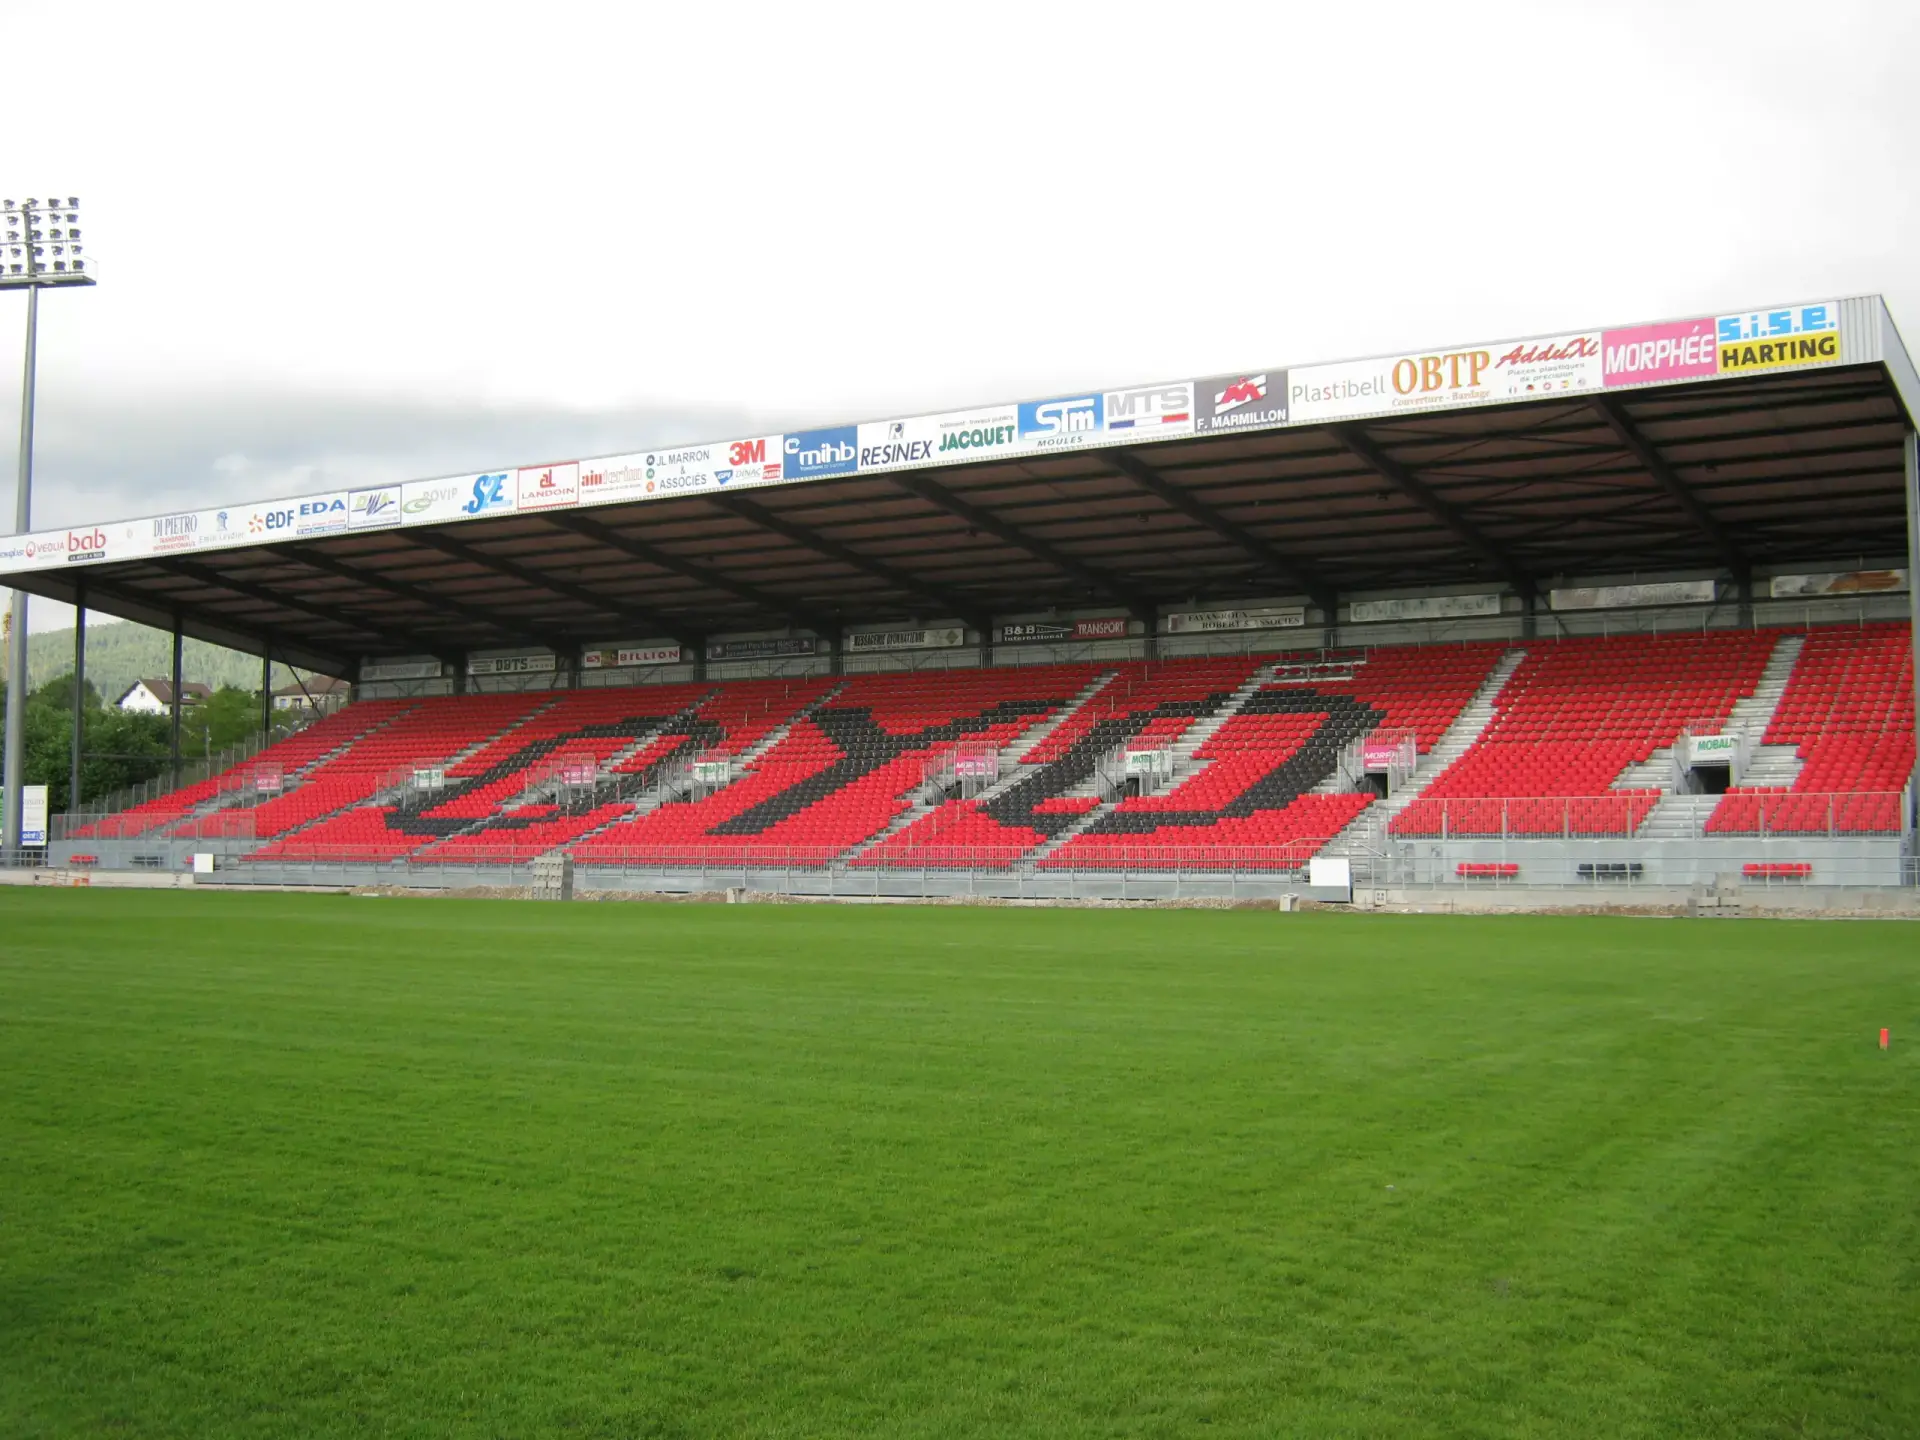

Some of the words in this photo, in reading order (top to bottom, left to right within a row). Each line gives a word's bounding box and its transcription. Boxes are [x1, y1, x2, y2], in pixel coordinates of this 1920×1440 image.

[1605, 325, 1715, 375] MORPHÉE
[1721, 336, 1836, 368] HARTING
[1391, 350, 1490, 395] OBTP
[1291, 375, 1386, 404] Plastibell
[1107, 386, 1190, 417] MTS
[1197, 418, 1207, 430] F.
[1211, 408, 1286, 429] MARMILLON
[938, 425, 1016, 452] JACQUET
[1037, 435, 1083, 447] MOULES
[656, 455, 667, 467] JL
[668, 449, 711, 465] MARRON
[728, 439, 766, 466] 3M
[860, 440, 933, 466] RESINEX
[680, 466, 686, 475] &
[521, 486, 576, 500] LANDOIN
[299, 499, 346, 516] EDA
[153, 519, 163, 537] DI
[164, 514, 198, 536] PIETRO
[36, 541, 64, 553] VEOLIA
[67, 527, 107, 552] bab
[1077, 621, 1125, 636] TRANSPORT
[619, 650, 679, 662] BILLION
